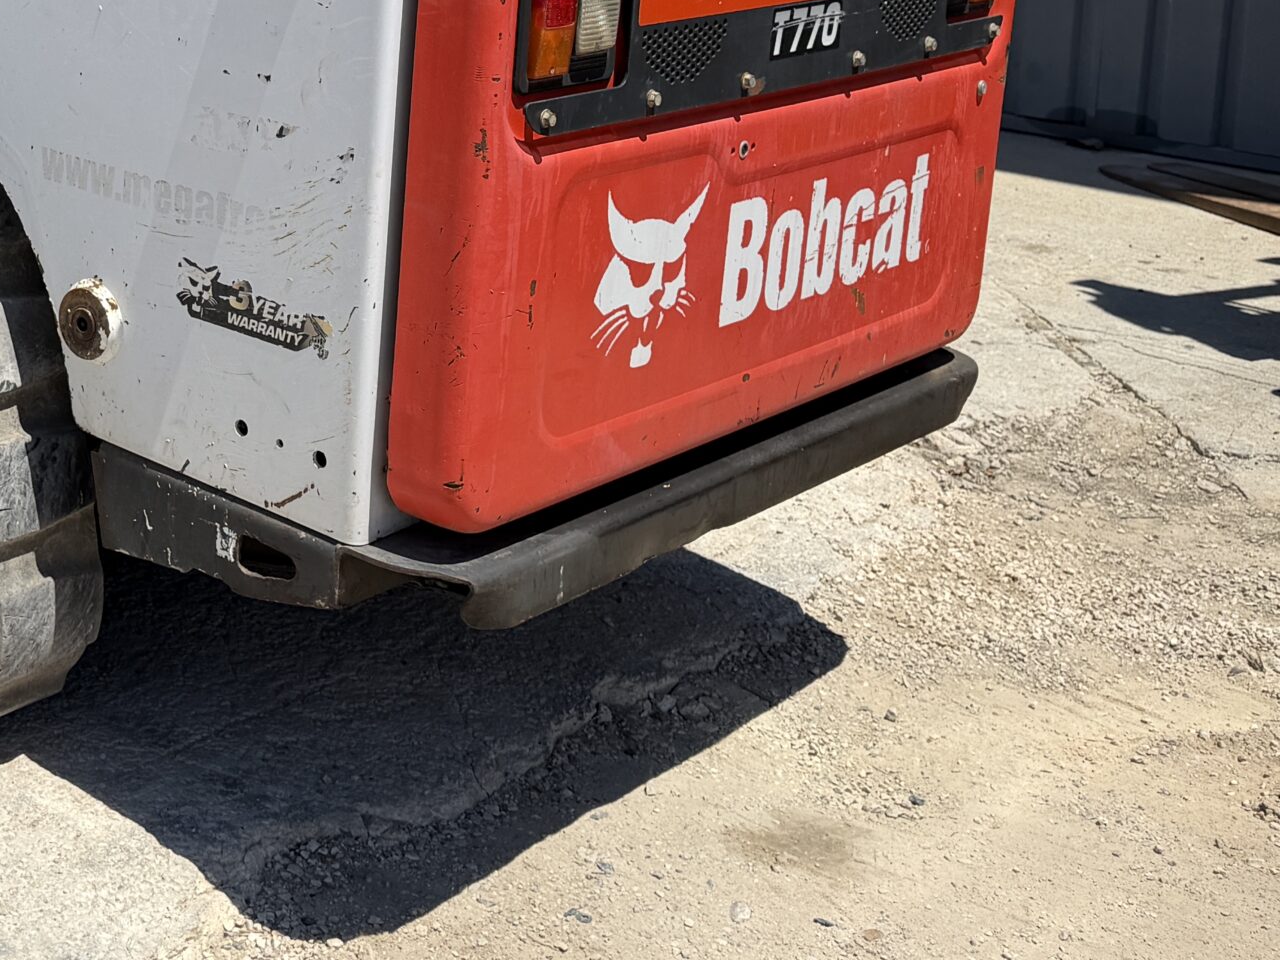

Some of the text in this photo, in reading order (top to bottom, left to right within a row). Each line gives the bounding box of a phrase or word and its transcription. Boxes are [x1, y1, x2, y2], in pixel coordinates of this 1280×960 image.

[772, 1, 843, 57] T770
[718, 153, 930, 328] Bobcat
[227, 311, 304, 347] WARRANTY
[228, 279, 307, 330] 3 YEAR
